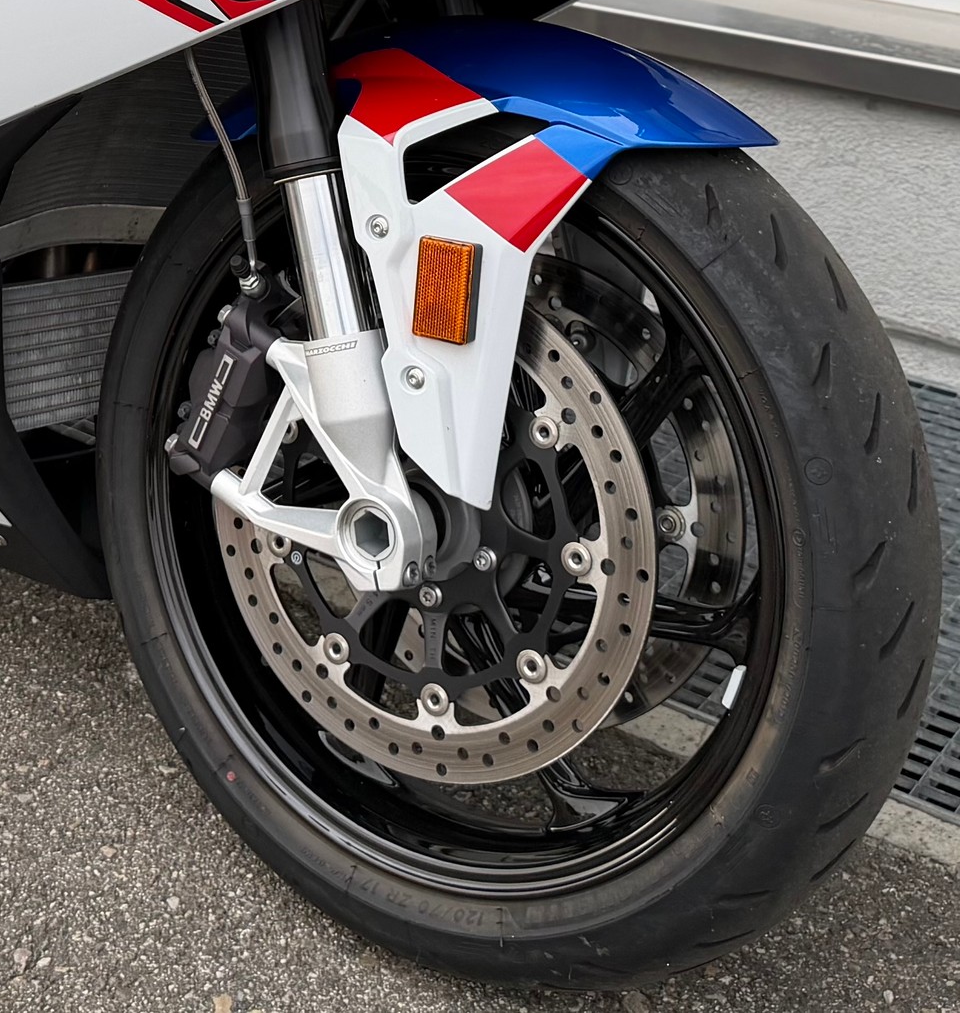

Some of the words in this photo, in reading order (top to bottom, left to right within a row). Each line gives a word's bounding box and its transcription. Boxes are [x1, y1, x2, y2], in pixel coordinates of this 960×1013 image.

[199, 378, 223, 424] BMW
[356, 876, 378, 896] 17
[385, 887, 413, 908] ZR
[417, 900, 485, 927] 120/70
